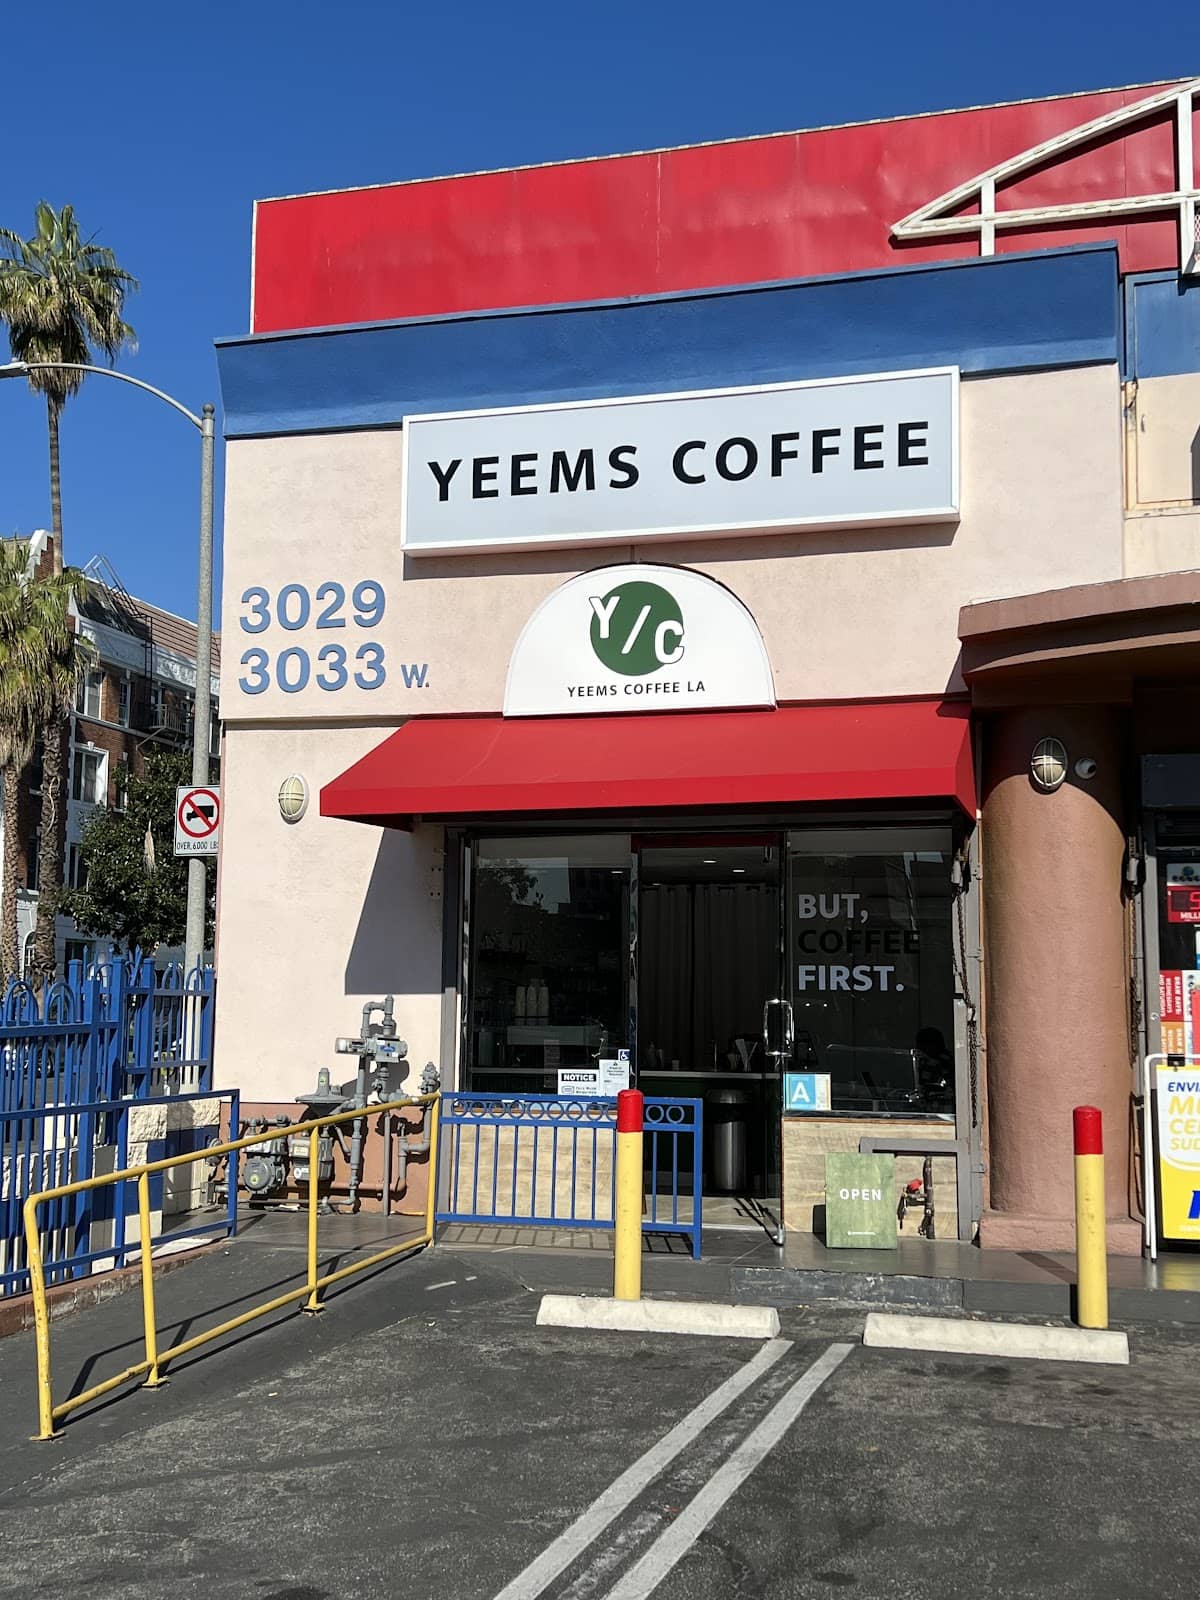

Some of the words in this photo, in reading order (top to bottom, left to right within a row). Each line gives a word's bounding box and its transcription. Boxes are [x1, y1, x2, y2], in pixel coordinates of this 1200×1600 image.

[427, 445, 640, 502] YEEMS
[672, 421, 929, 485] COFFEE
[239, 579, 386, 634] 3029
[238, 642, 387, 695] 3033
[401, 663, 430, 688] W.
[567, 684, 618, 697] YEEMS
[624, 682, 680, 695] COFFEE
[687, 681, 706, 692] LA
[192, 841, 208, 850] 6000
[798, 893, 869, 924] BUT,
[798, 929, 920, 954] COFFEE
[798, 965, 905, 992] FIRST.
[563, 1073, 595, 1081] NOTICE
[791, 1081, 811, 1103] A
[839, 1188, 882, 1201] OPEN
